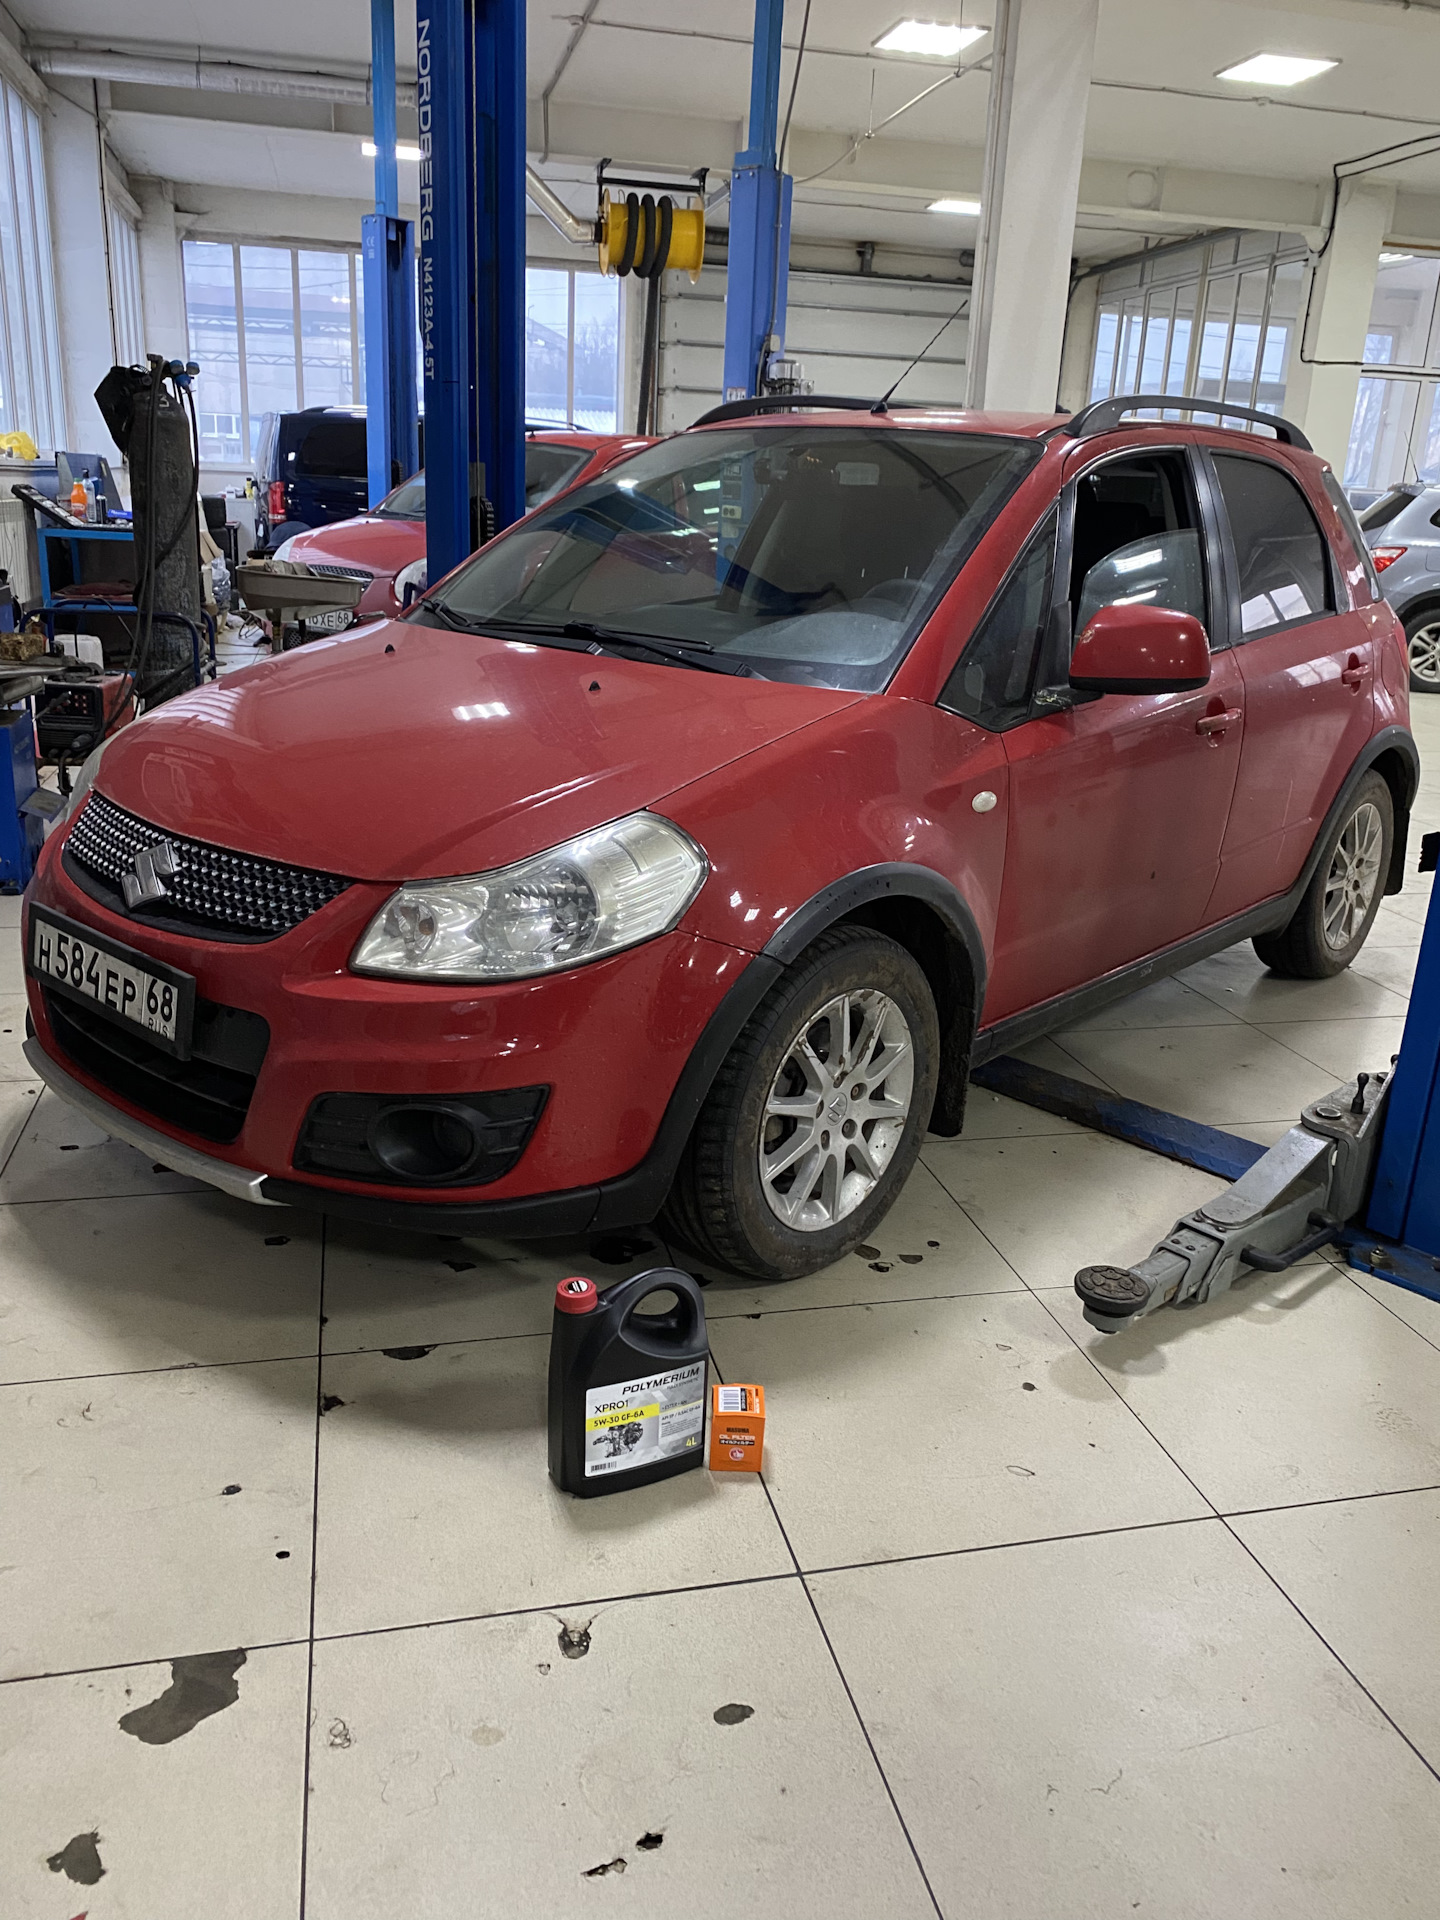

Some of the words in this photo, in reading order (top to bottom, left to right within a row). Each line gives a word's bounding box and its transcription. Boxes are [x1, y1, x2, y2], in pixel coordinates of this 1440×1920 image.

[417, 18, 434, 242] NORDBERG
[423, 257, 435, 381] N4123A-4.5T
[337, 611, 350, 625] 68
[146, 978, 174, 1022] 68
[148, 1016, 171, 1039] RUS
[622, 1366, 700, 1396] POLYMERIUM
[594, 1400, 629, 1414] XPRO1
[594, 1415, 620, 1427] 5W-30
[621, 1410, 645, 1421] GF-6A
[686, 1436, 697, 1447] 4L
